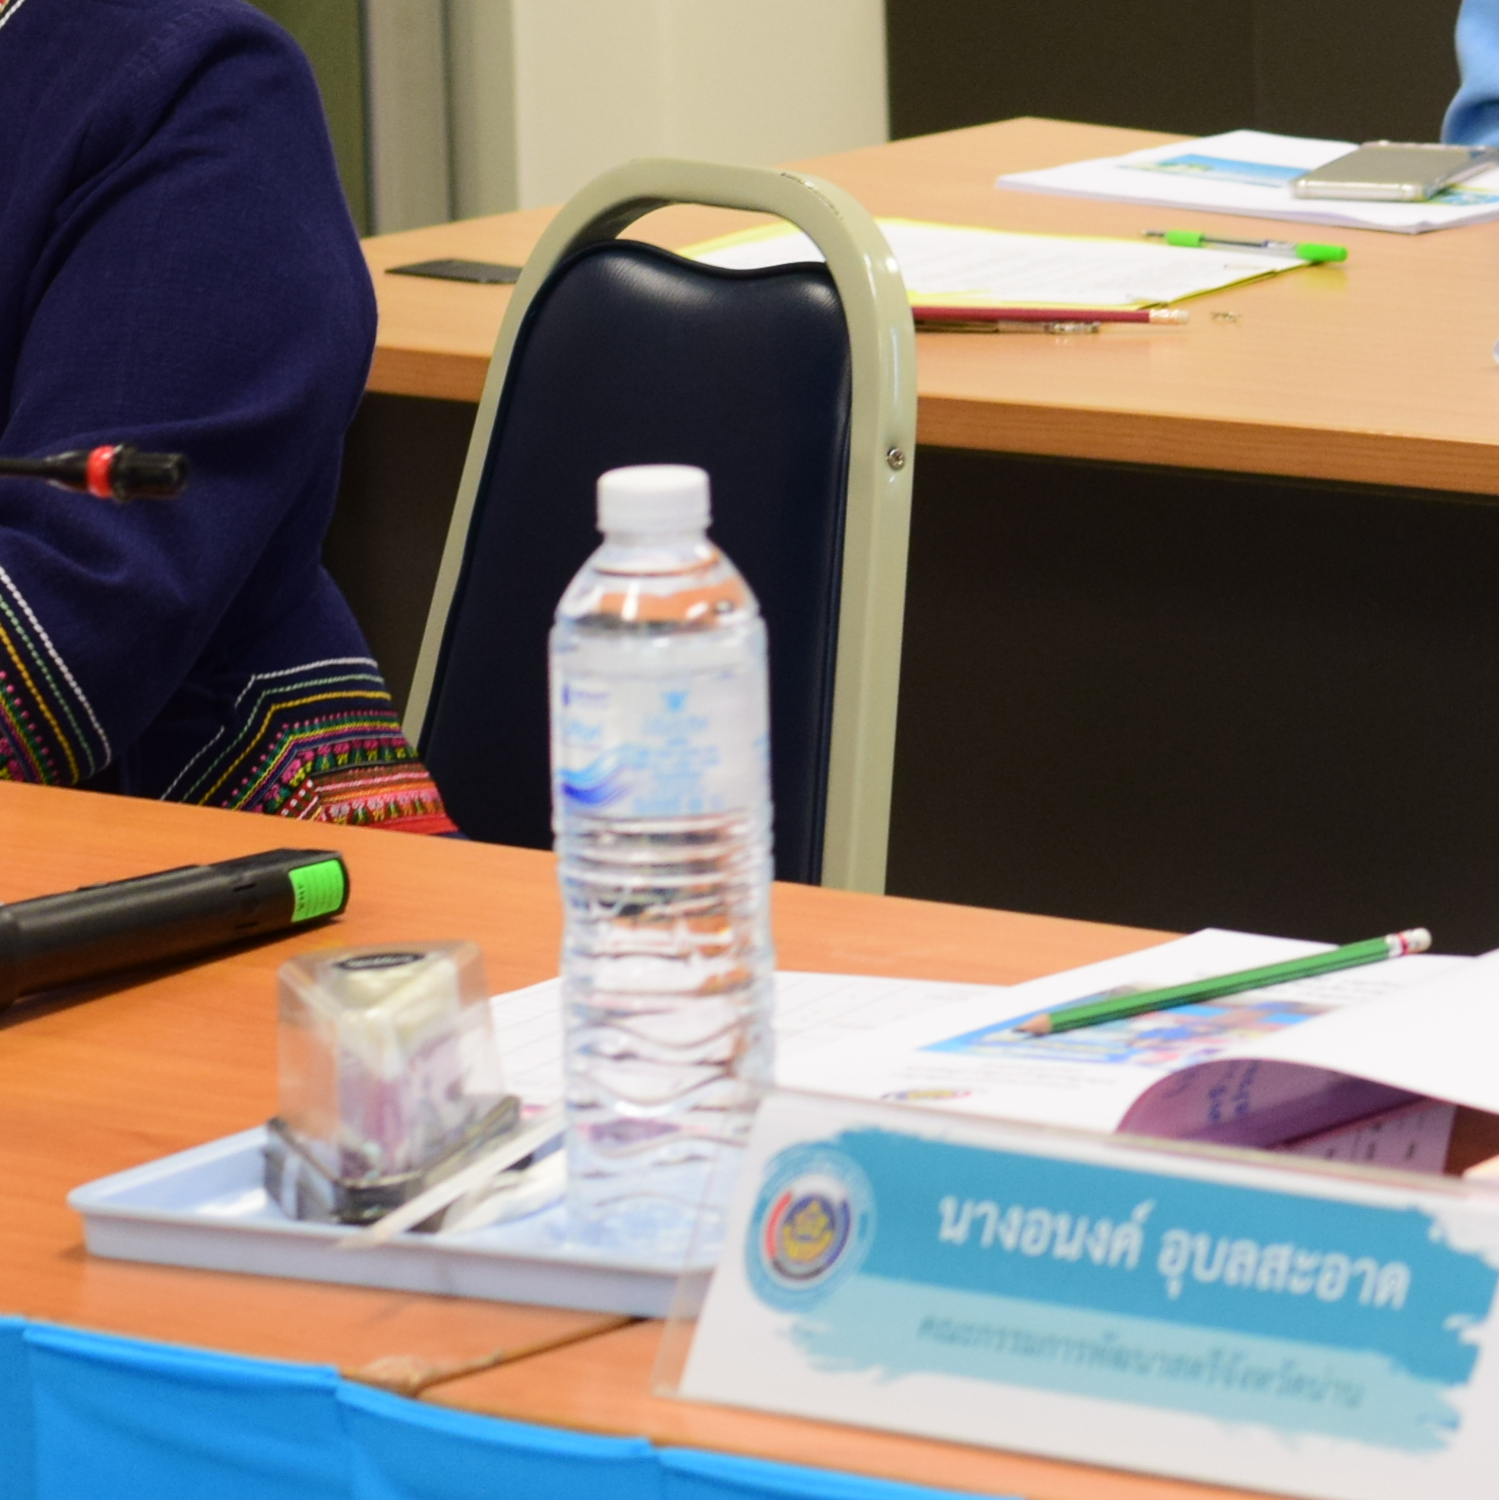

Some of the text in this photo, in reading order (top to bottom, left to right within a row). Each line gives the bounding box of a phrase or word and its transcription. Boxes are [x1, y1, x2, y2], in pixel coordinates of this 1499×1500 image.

[937, 1194, 1158, 1271] นางอนงค์
[1156, 1228, 1413, 1310] อุบลสะอาด
